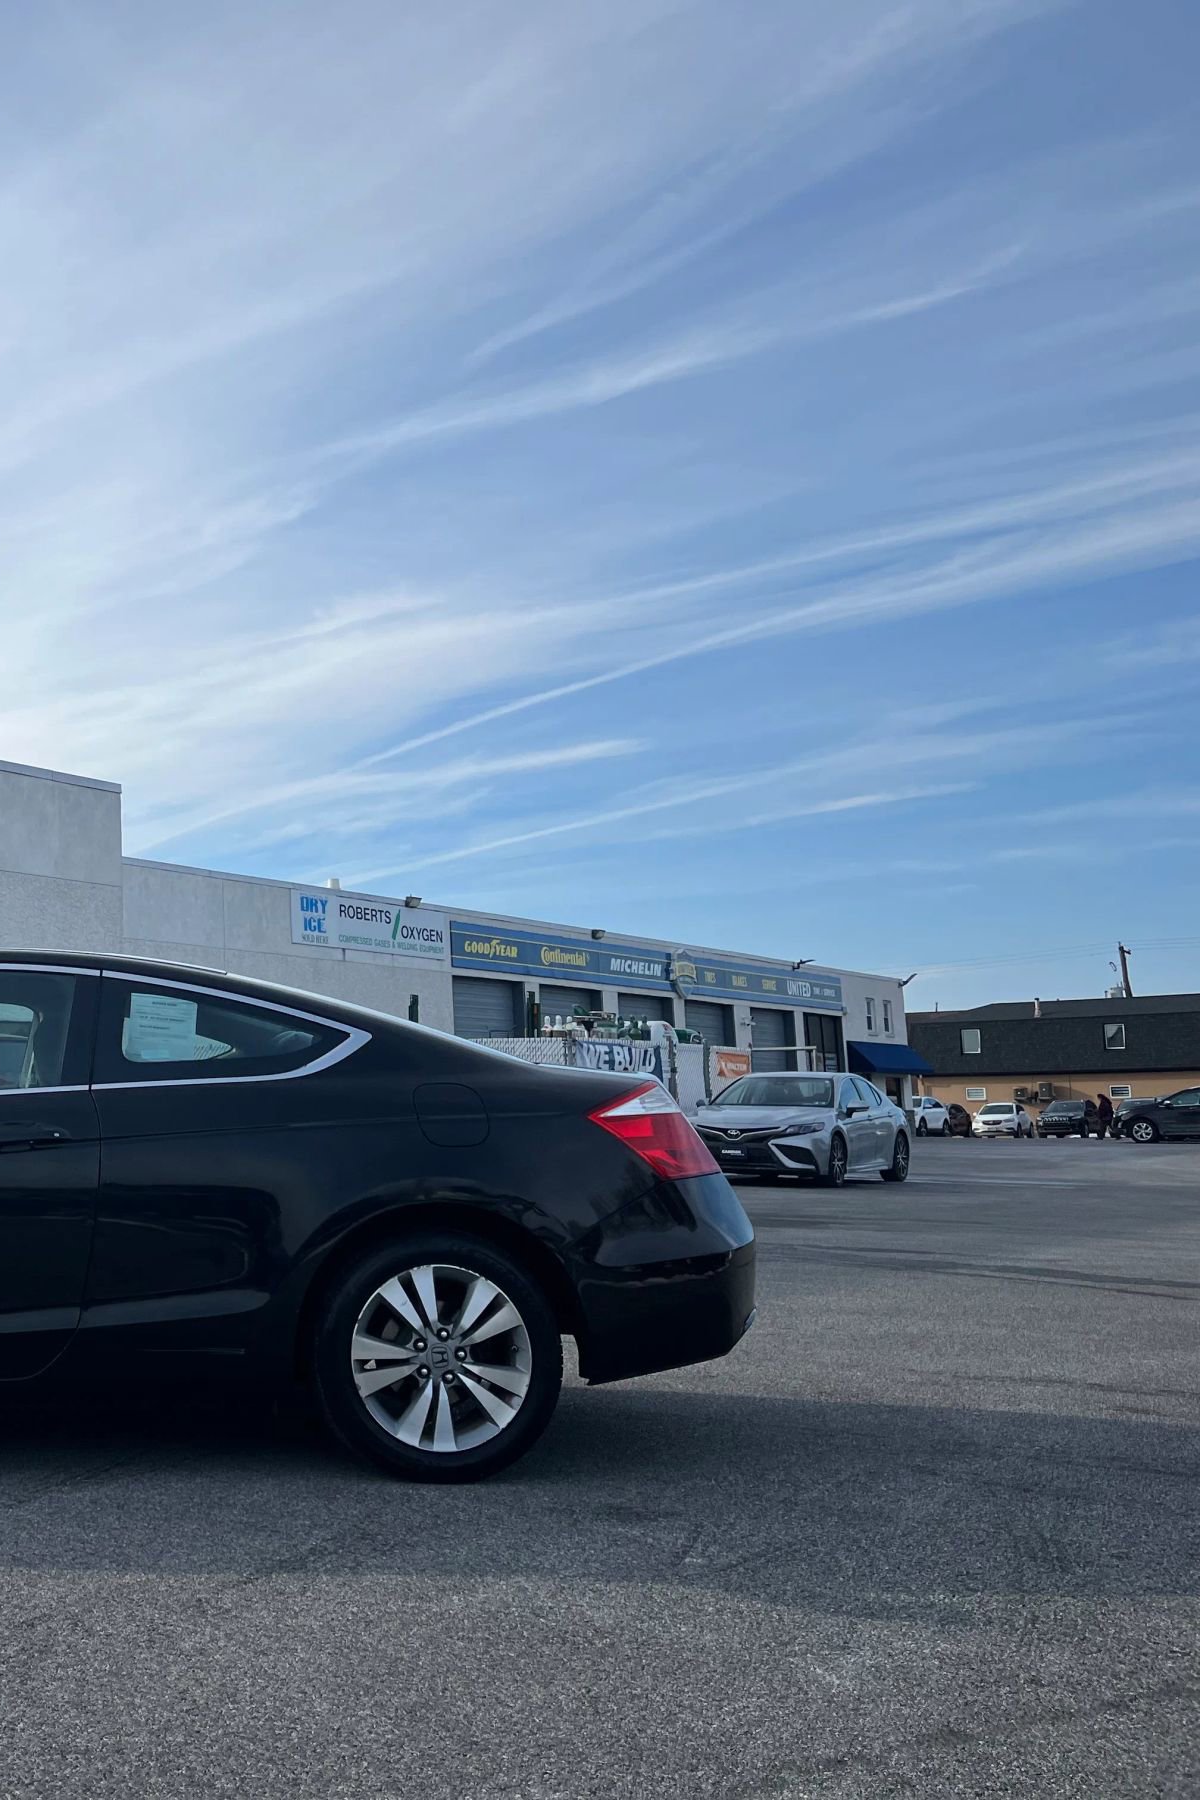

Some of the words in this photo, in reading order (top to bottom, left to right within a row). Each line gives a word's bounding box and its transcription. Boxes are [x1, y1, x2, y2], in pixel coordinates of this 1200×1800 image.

[300, 896, 328, 914] DRY
[339, 904, 392, 925] ROBERTS
[303, 916, 327, 934] ICE
[400, 925, 443, 943] OXYGEN
[338, 934, 372, 946] COMPRESSED
[374, 938, 390, 948] GASES
[397, 941, 418, 952] WELDING
[419, 944, 444, 954] EQUIPMENT
[464, 939, 518, 959] GOODYEAR
[541, 946, 586, 966] Continental
[610, 957, 662, 977] MICHELIN
[786, 980, 811, 997] UNITED
[577, 1042, 609, 1070] WE
[613, 1045, 656, 1073] BUILD
